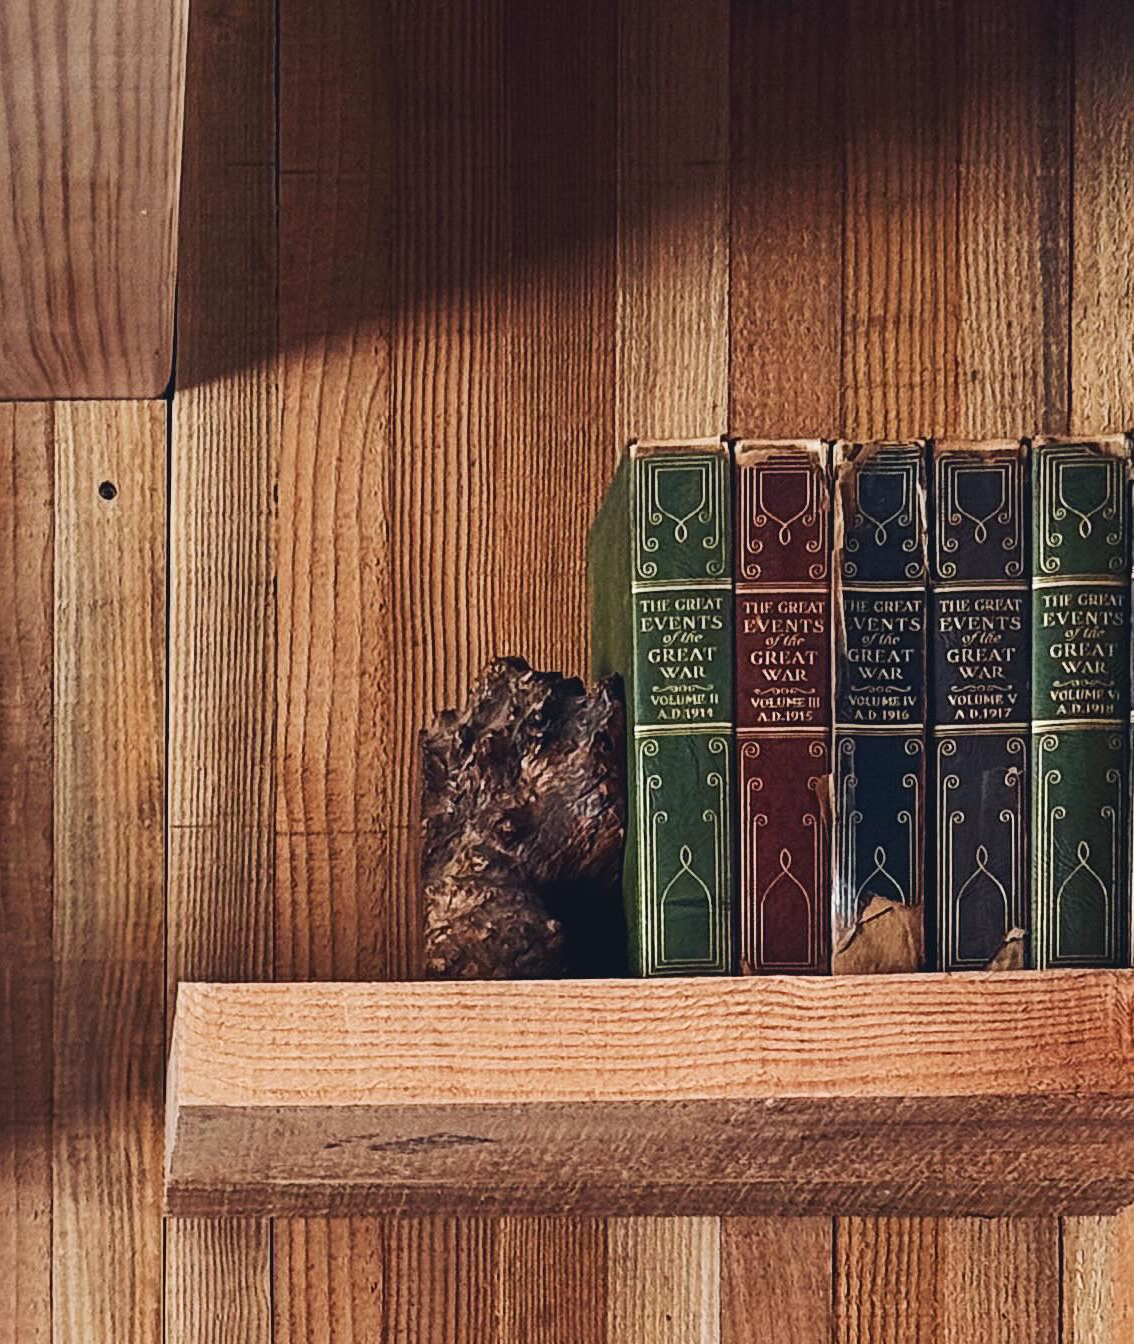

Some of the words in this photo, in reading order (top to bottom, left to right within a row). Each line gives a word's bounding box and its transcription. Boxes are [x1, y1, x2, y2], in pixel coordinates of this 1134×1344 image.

[640, 599, 670, 613] THE
[675, 598, 723, 611] GREAT
[844, 600, 867, 613] HE
[874, 600, 922, 612] GREAT
[939, 600, 970, 613] THE
[974, 599, 1022, 612] GREAT
[1043, 595, 1071, 607] THE
[1078, 593, 1123, 607] GREAT
[744, 602, 772, 615] THE
[778, 601, 825, 614] GREAT
[641, 616, 723, 632] EVENTS
[744, 618, 825, 634] EVENTS
[849, 617, 921, 632] VENTS
[939, 616, 1021, 632] EVENTS
[1043, 611, 1124, 627] EVENTS
[663, 630, 680, 645] of
[681, 631, 703, 643] the
[862, 633, 879, 646] of
[879, 632, 900, 645] the
[962, 631, 979, 647] of
[980, 631, 1002, 644] the
[1065, 627, 1080, 642] of
[1083, 626, 1106, 639] the
[766, 634, 781, 649] of
[783, 634, 805, 646] the
[648, 647, 716, 663] GREAT
[750, 651, 818, 665] GREAT
[848, 649, 914, 663] GREAT
[946, 648, 1016, 663] GREAT
[1050, 643, 1116, 659] GREAT
[660, 666, 706, 679] WAR
[858, 667, 903, 680] WAR
[960, 666, 1006, 679] WAR
[1061, 661, 1108, 675] WAR
[762, 669, 809, 682] WAR
[650, 694, 706, 706] VOLUME
[751, 697, 806, 709] VOLUME
[808, 697, 820, 708] III
[849, 695, 900, 706] VOLUME
[903, 696, 916, 706] IV
[947, 695, 1004, 705] VOLUME
[1008, 694, 1018, 704] V
[1050, 690, 1103, 702] VOLUME
